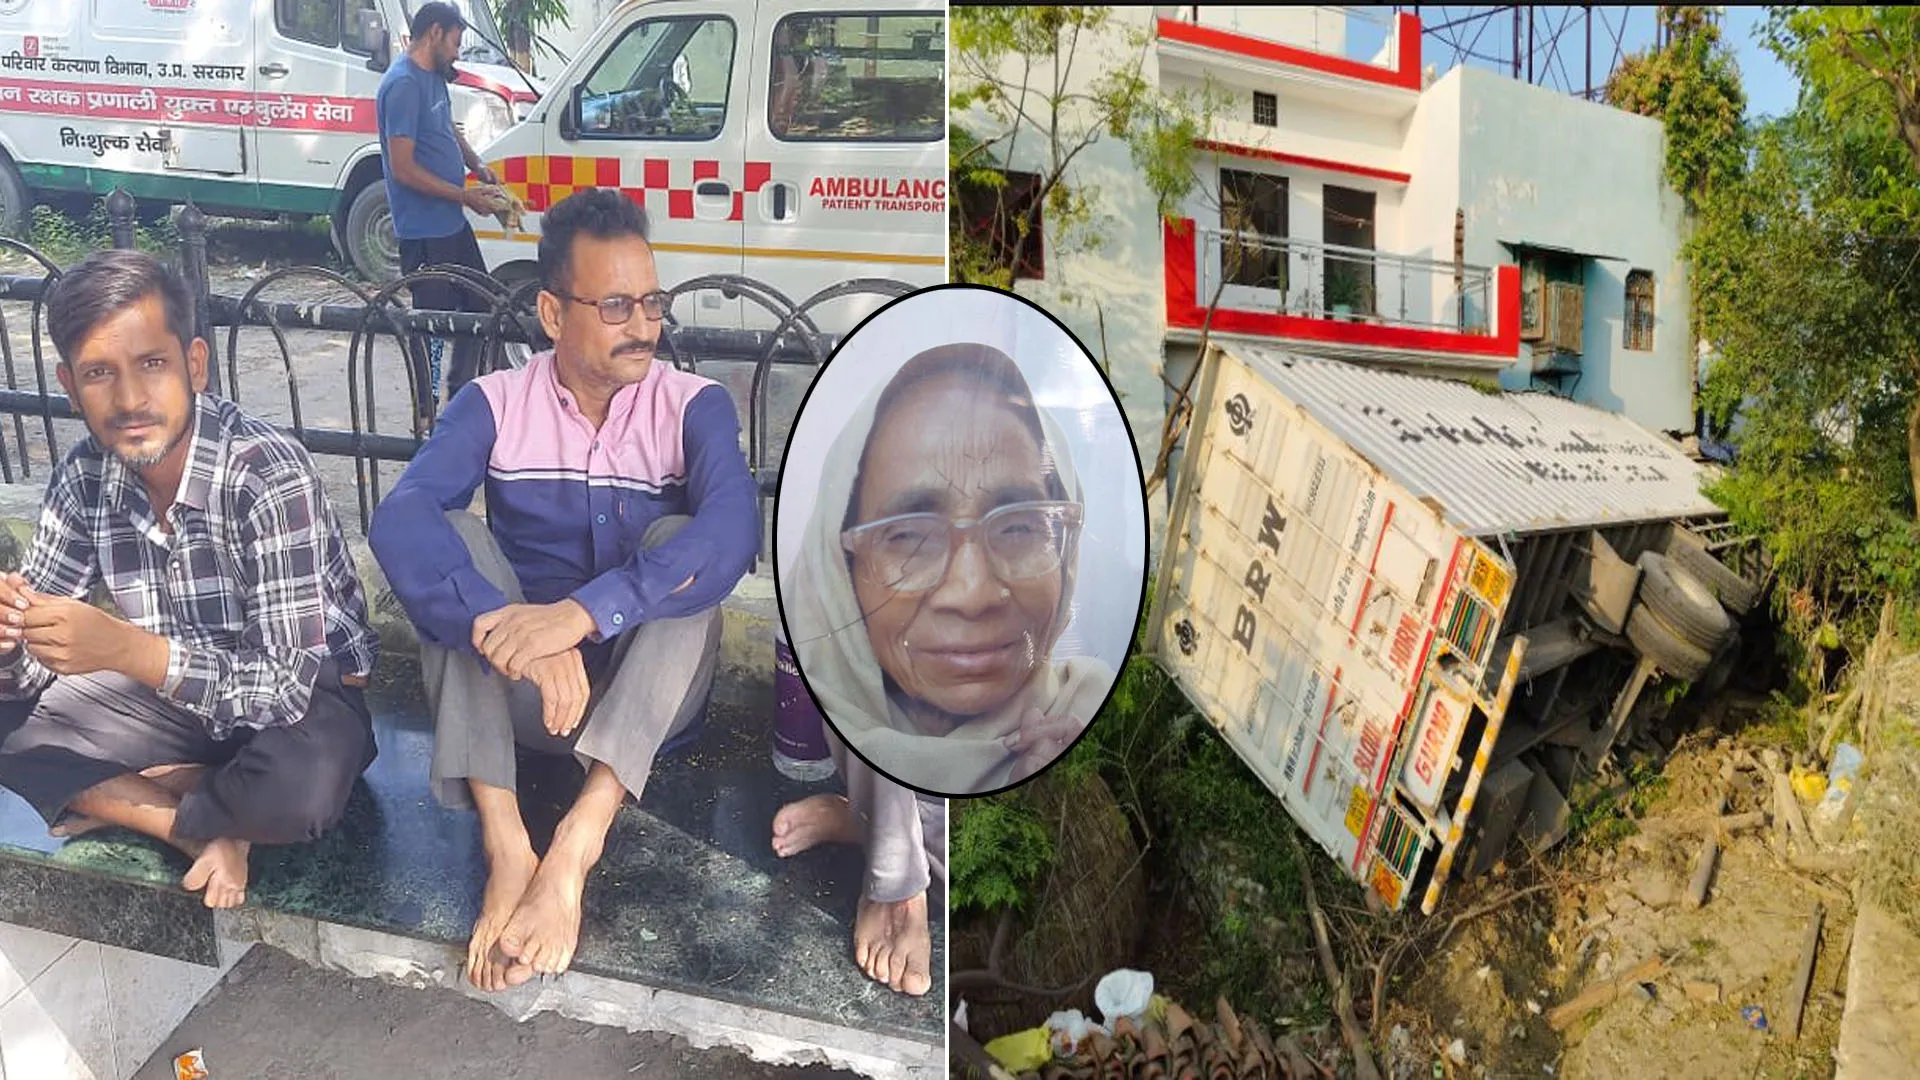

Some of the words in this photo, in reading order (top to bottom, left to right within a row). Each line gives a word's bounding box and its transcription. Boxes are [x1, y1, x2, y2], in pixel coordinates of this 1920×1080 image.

[2, 51, 46, 71] परिवार
[51, 58, 100, 75] कल्याण
[104, 55, 153, 79] विभाग,
[157, 63, 187, 78] उ.प्र.
[192, 64, 246, 81] सरकार
[26, 88, 82, 106] रक्षक
[86, 88, 158, 111] प्रणाली
[163, 95, 216, 120] युक्त
[312, 98, 354, 122] सेवा
[809, 177, 945, 199] AMBULANC
[822, 199, 871, 210] PATIENT
[875, 200, 946, 213] TRANSPORT
[1388, 612, 1421, 671] HORN
